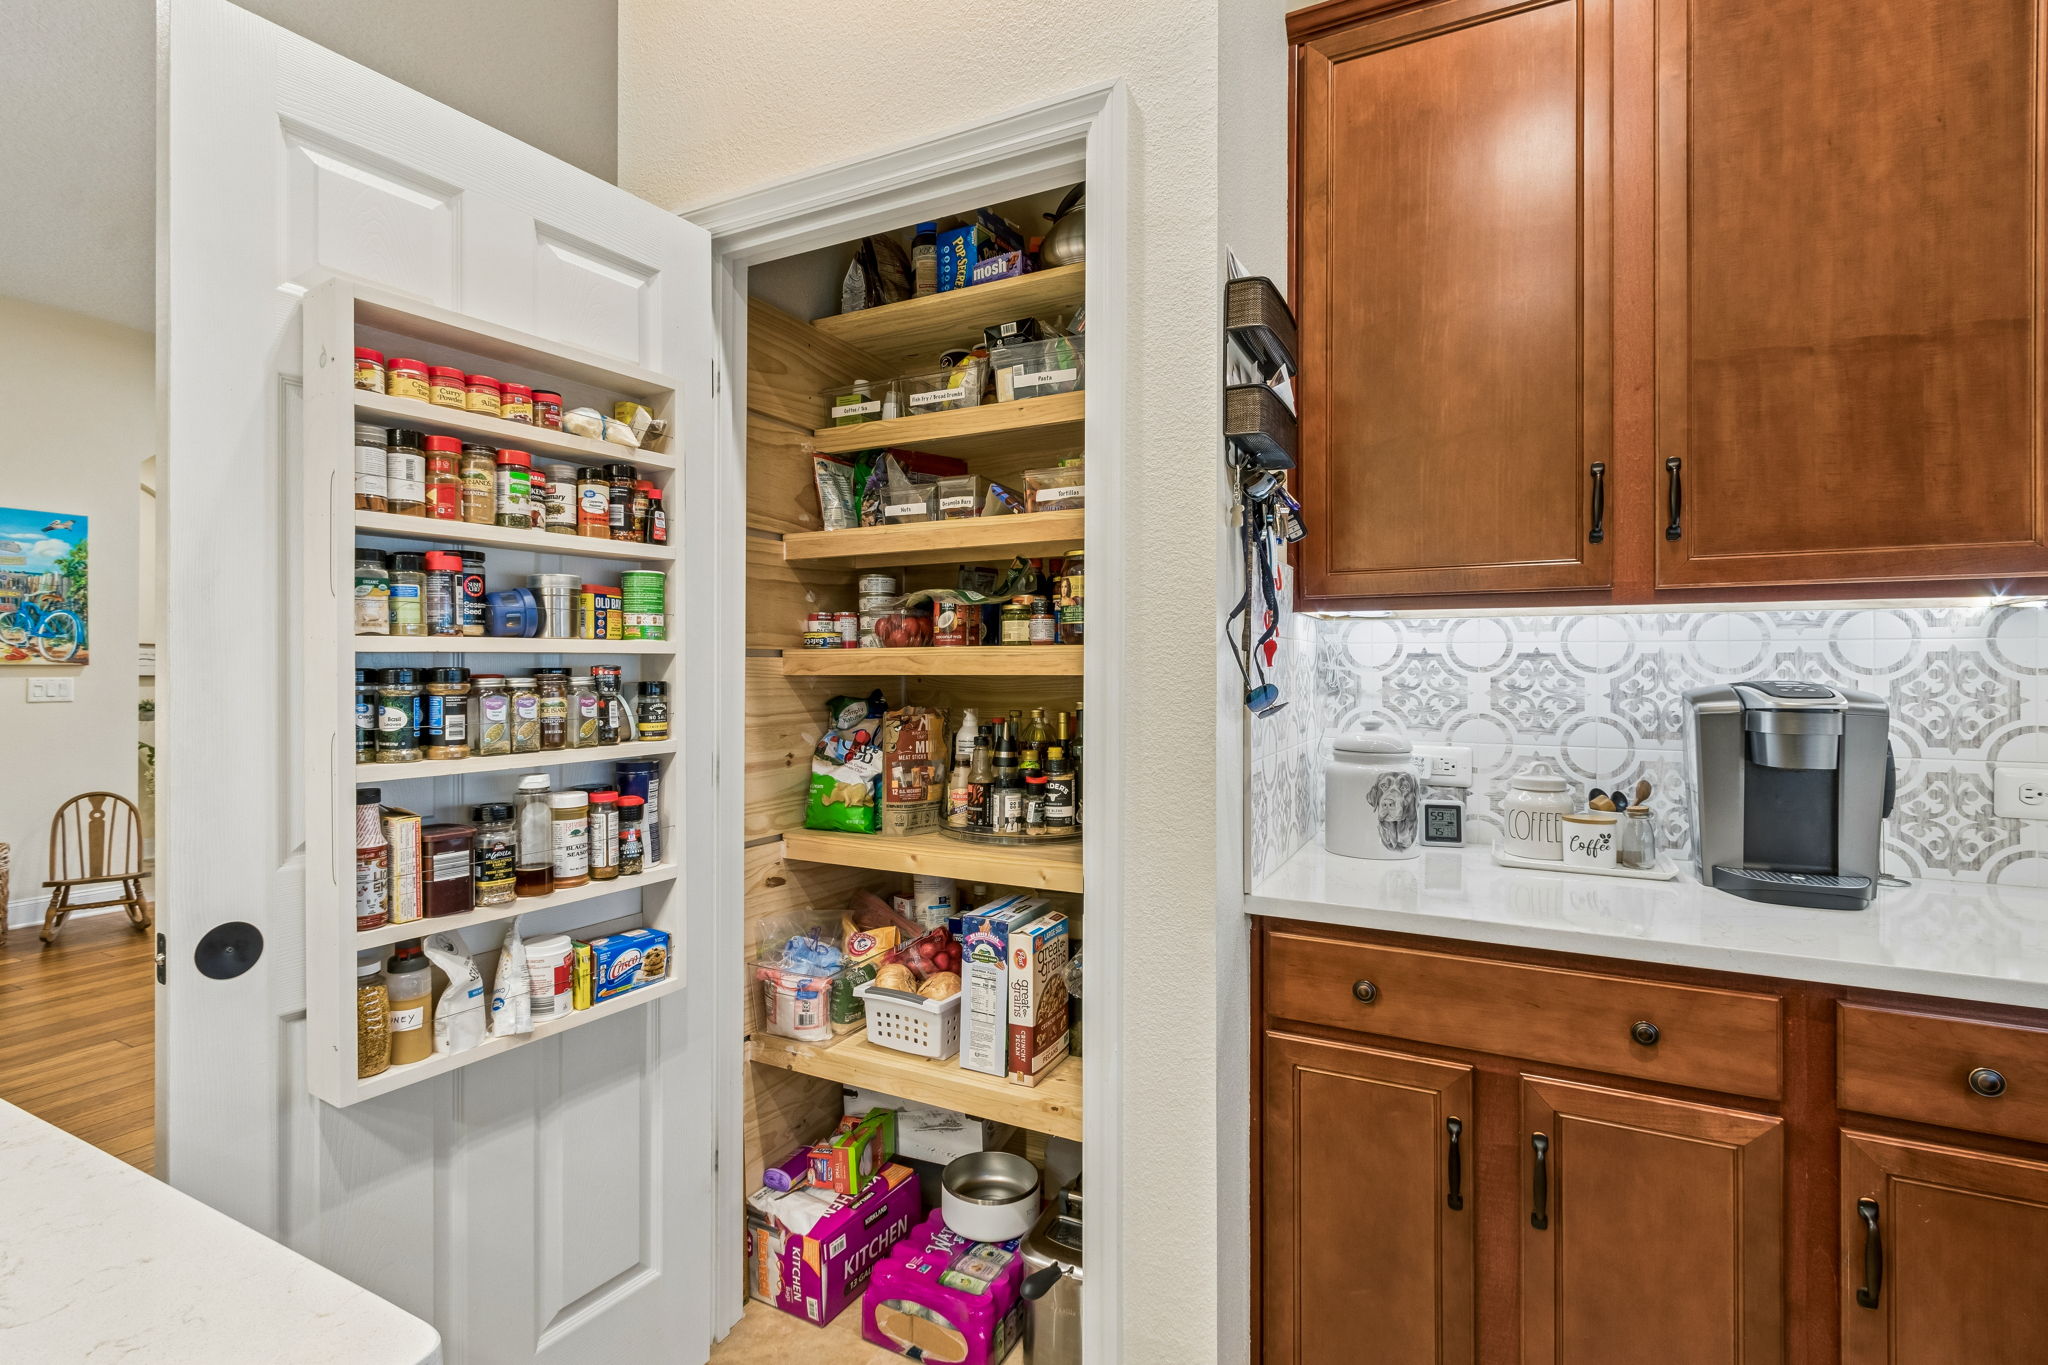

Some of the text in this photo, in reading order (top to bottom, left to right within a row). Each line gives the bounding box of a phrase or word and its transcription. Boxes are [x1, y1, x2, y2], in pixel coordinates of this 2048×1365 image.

[952, 236, 968, 290] POP SECRE
[973, 258, 1008, 281] mosh
[439, 394, 463, 404] Powder
[440, 387, 461, 397] Curry
[843, 406, 857, 414] Coffee
[1058, 489, 1080, 497] Tortillas
[941, 499, 960, 507] Granola
[463, 601, 486, 609] Sesam
[595, 597, 622, 610] OLD BAY
[843, 707, 864, 717] Simply
[891, 788, 899, 796] 12
[1430, 811, 1444, 821] 59
[1508, 808, 1563, 843] COFFEE
[1569, 834, 1612, 859] Coffee
[1037, 936, 1061, 964] great
[610, 954, 640, 979] Crisco
[1016, 951, 1026, 968] Post
[1037, 949, 1066, 983] grains
[1011, 979, 1021, 1018] grains
[1020, 979, 1030, 1009] great
[390, 1013, 415, 1025] ONEY
[1042, 1045, 1059, 1064] PECANS
[864, 1204, 888, 1226] KIRKLAND
[843, 1214, 909, 1280] KITCHEN
[791, 1246, 803, 1303] KITCHEN
[849, 1278, 858, 1290] 13
